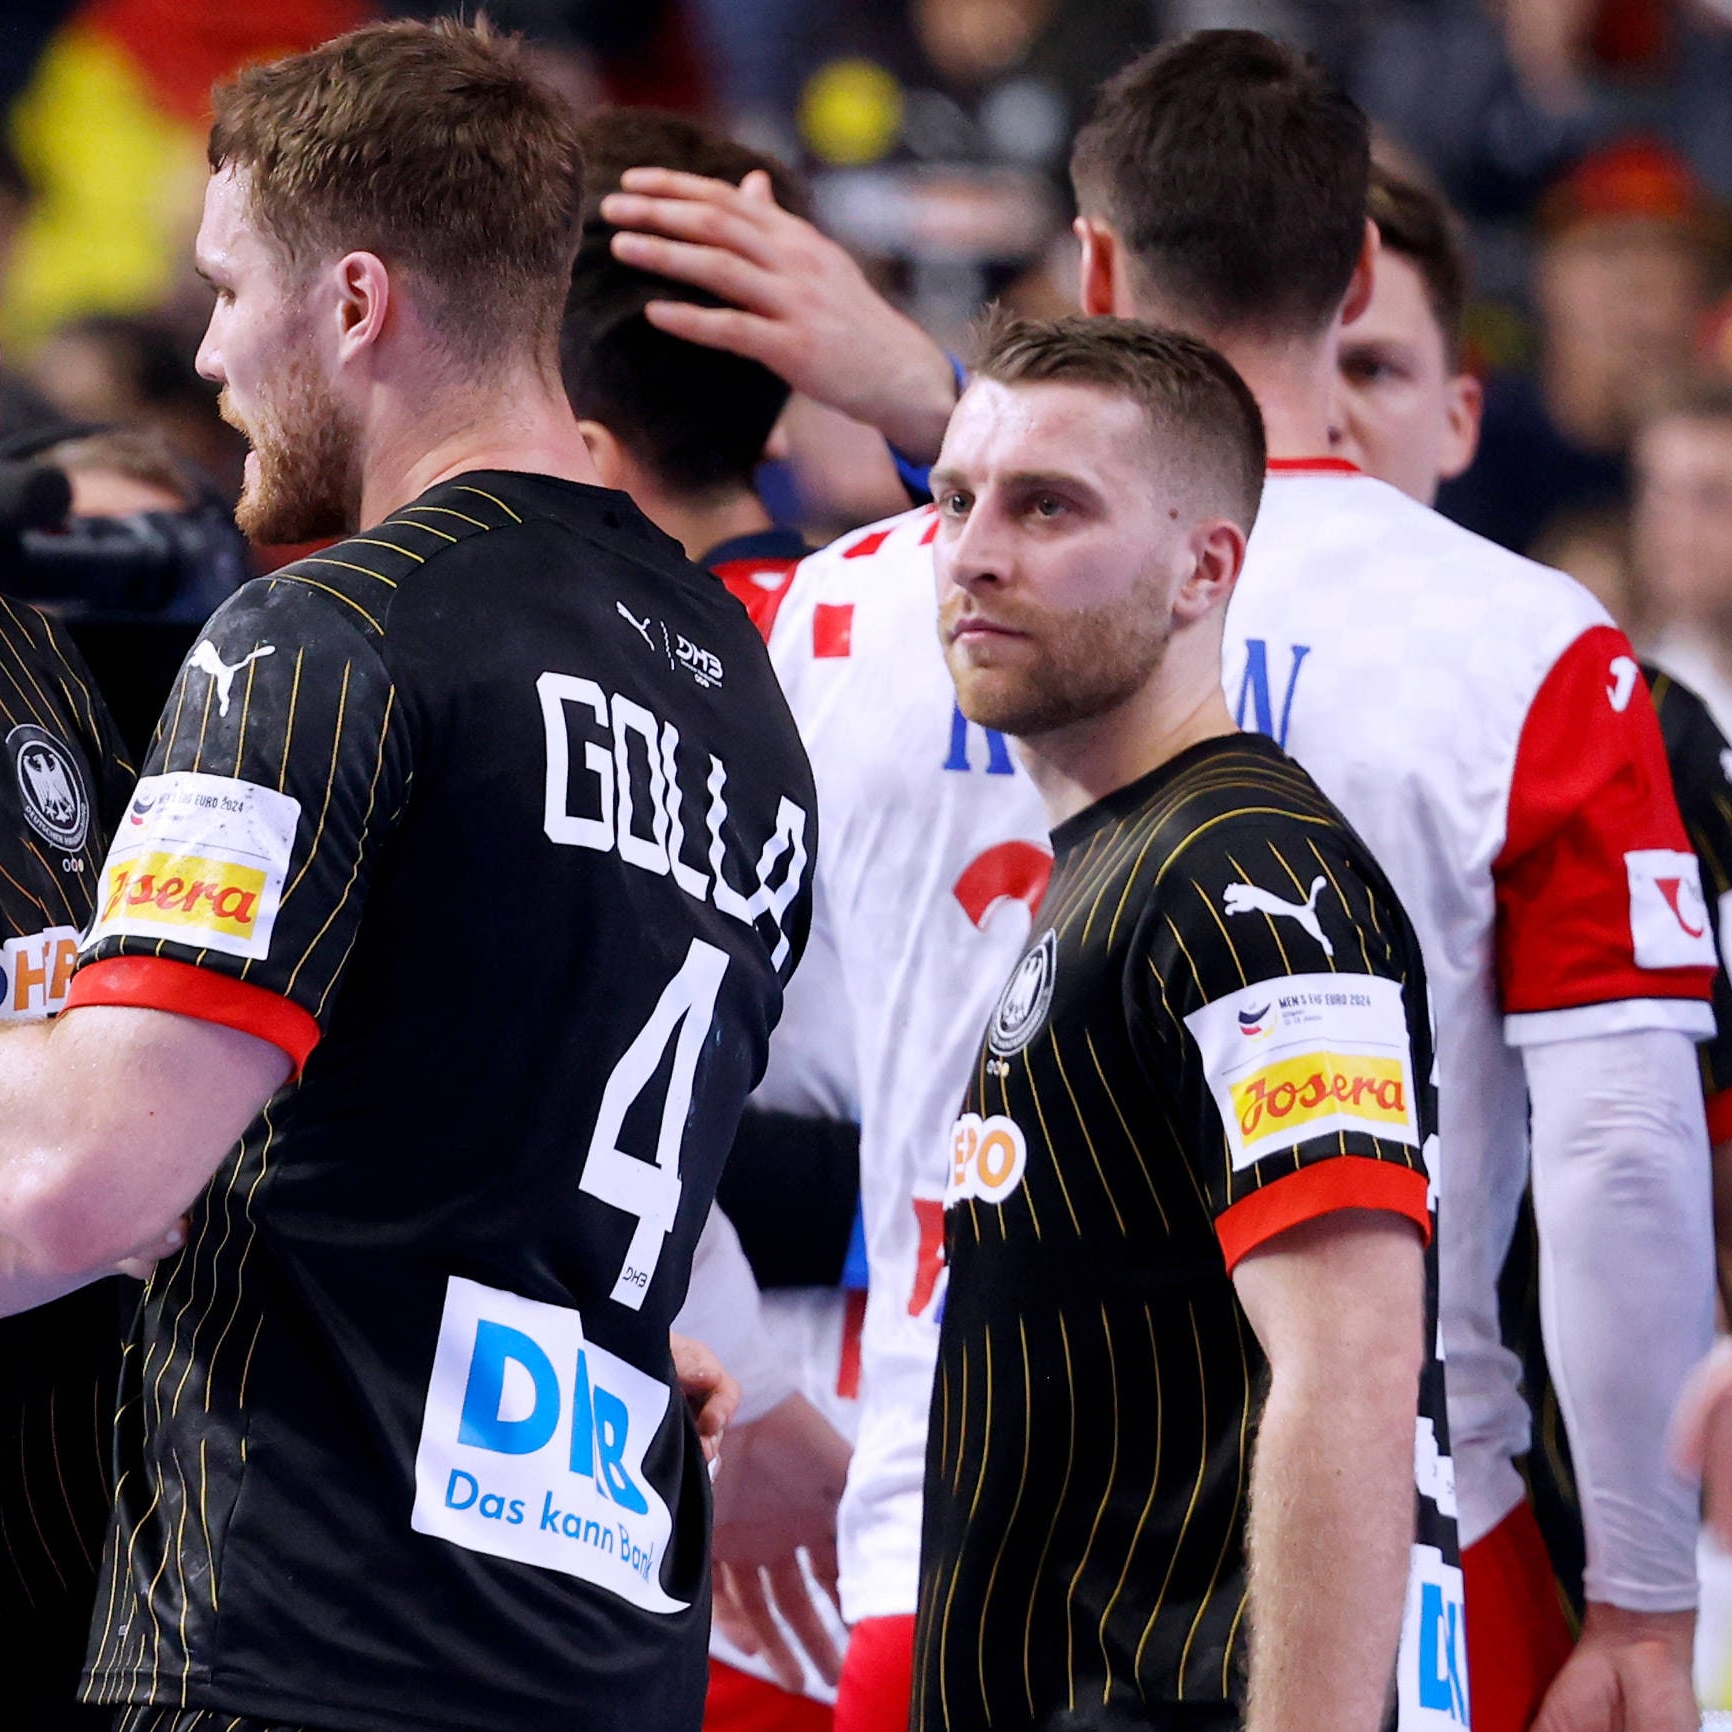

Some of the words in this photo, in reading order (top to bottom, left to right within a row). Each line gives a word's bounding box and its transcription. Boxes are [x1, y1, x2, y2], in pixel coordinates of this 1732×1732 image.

[675, 633, 723, 679] DHB
[194, 793, 218, 809] EURO
[220, 796, 244, 813] 2024
[536, 671, 809, 974] GOLLA
[101, 871, 256, 924] Jsera
[578, 937, 731, 1312] 4
[1241, 1072, 1406, 1136] Josera
[623, 1266, 648, 1288] DHB
[445, 1468, 526, 1525] Das
[539, 1490, 614, 1554] kann
[618, 1521, 655, 1584] Bank
